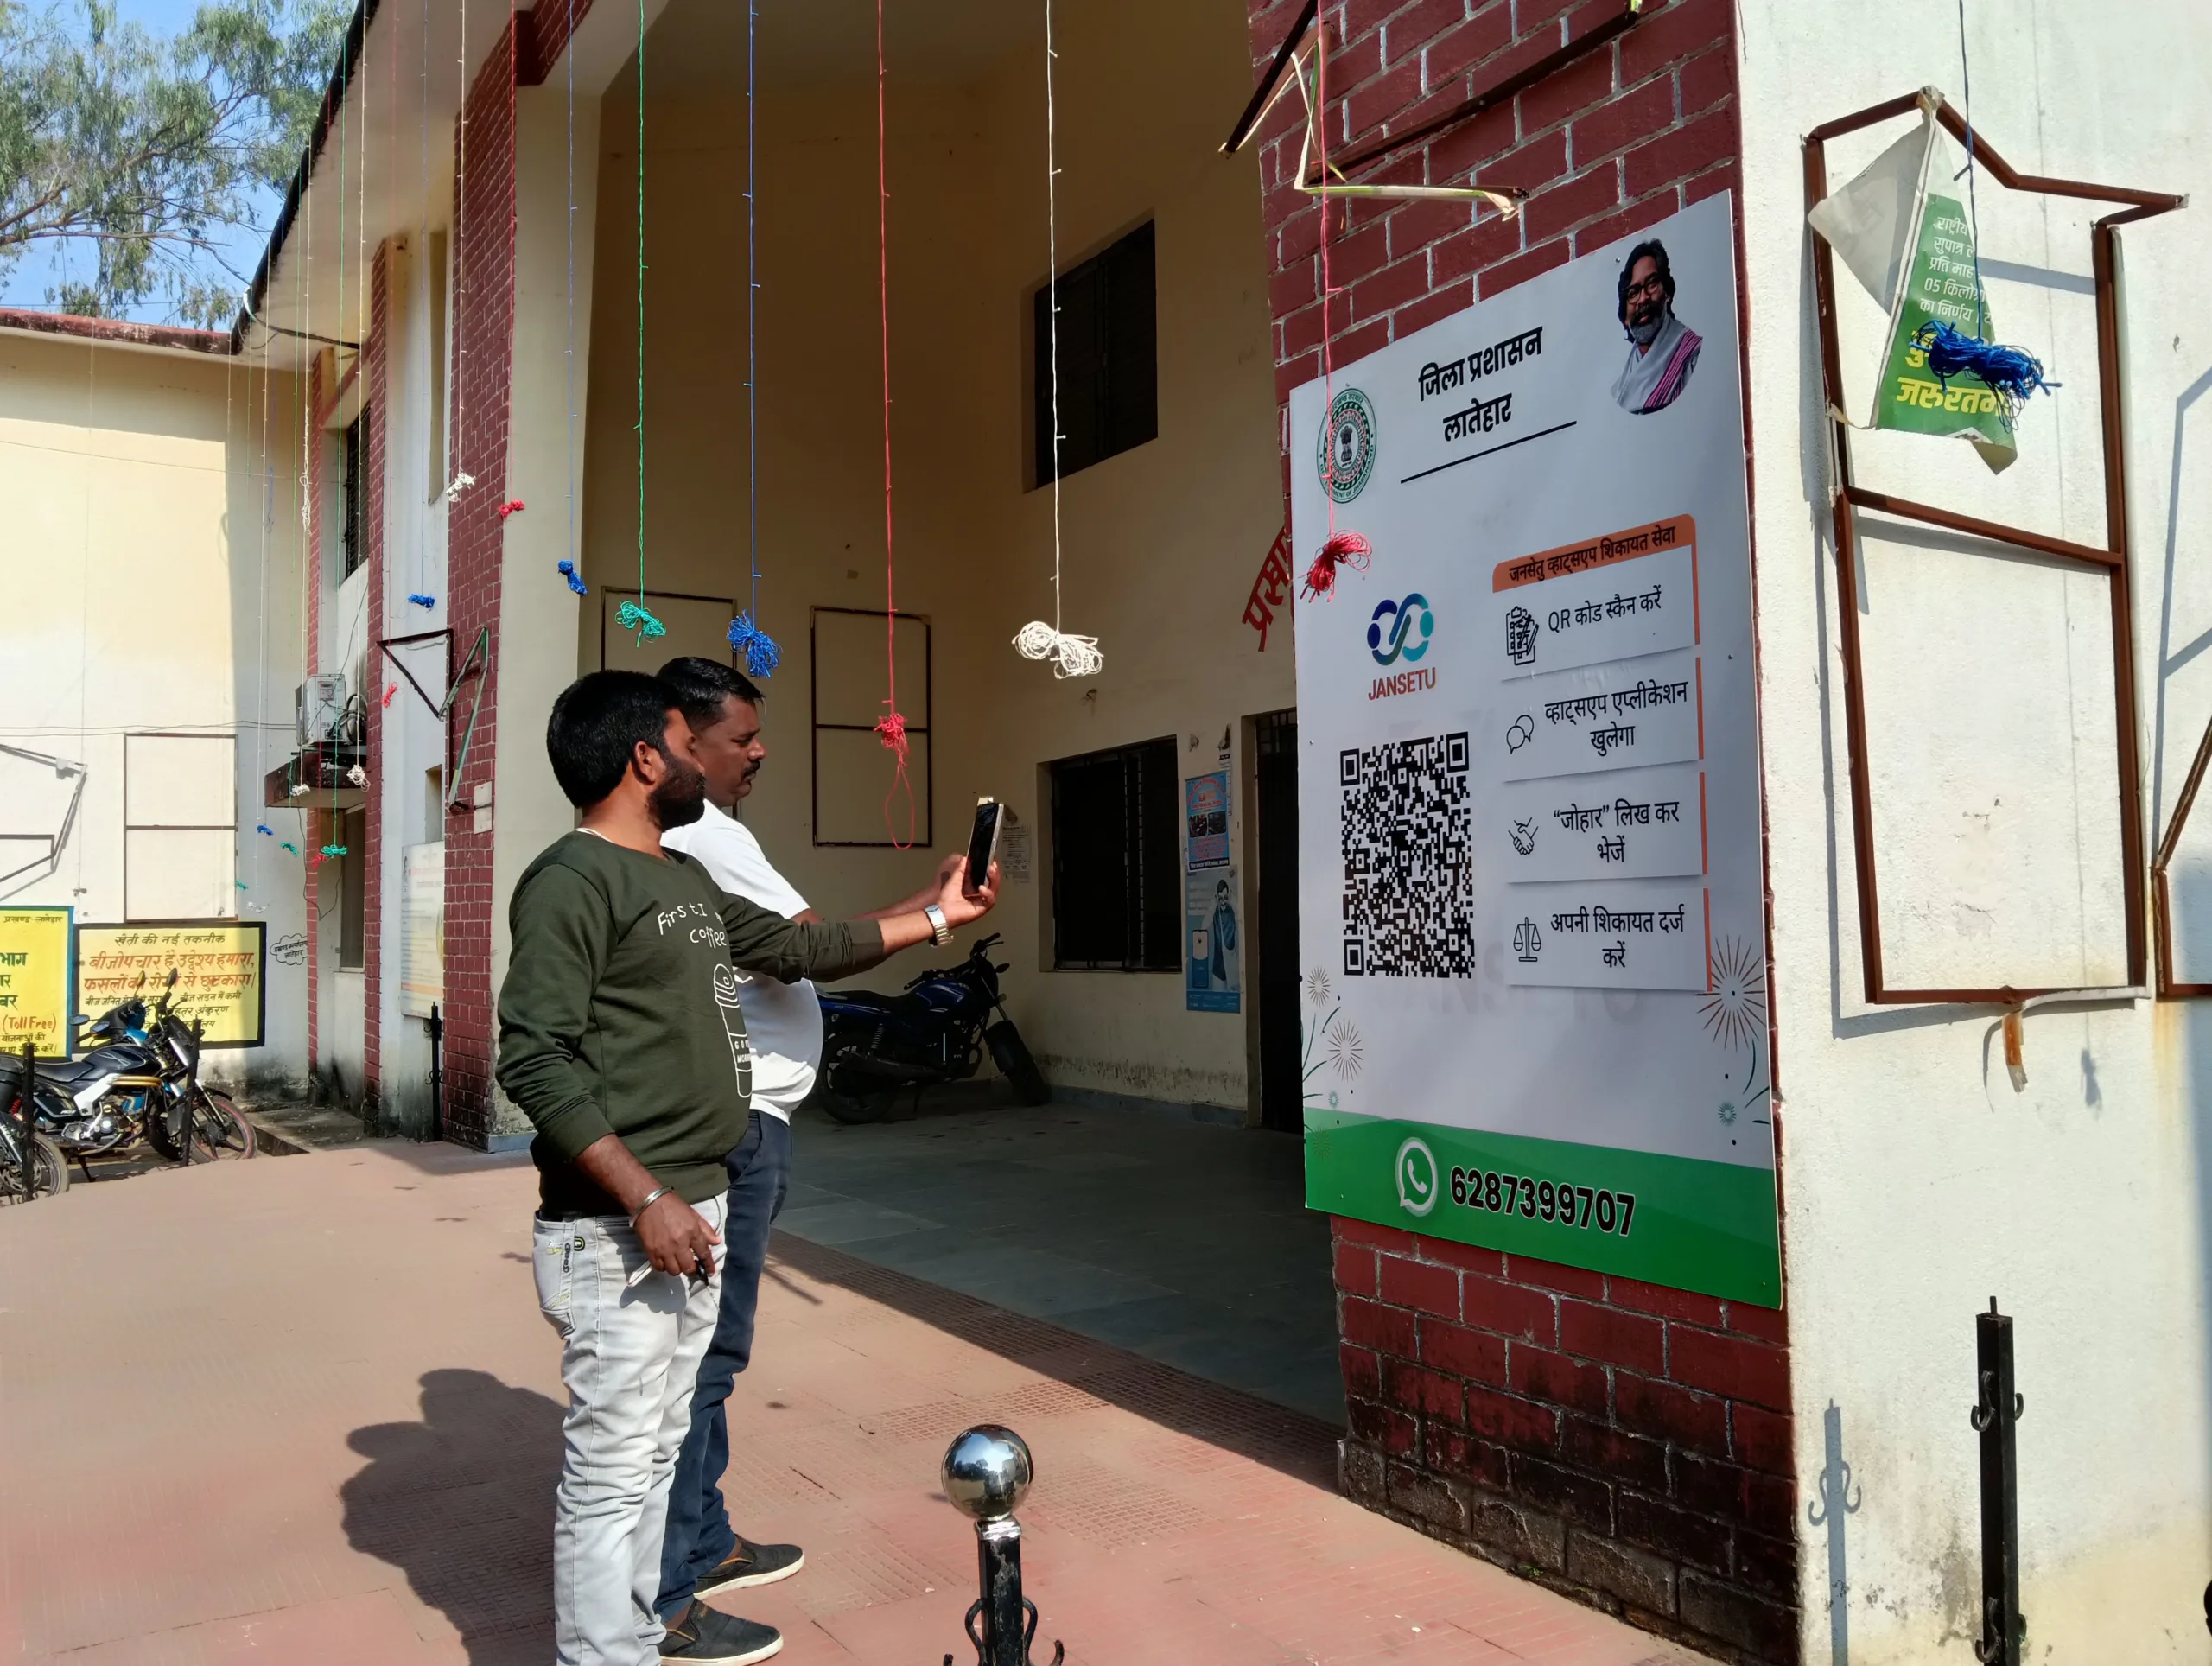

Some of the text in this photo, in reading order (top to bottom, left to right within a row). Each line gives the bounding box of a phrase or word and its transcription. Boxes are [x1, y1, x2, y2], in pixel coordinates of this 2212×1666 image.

[1933, 236, 1965, 256] सुपात्र
[1928, 255, 1976, 279] प्रति माह
[1923, 277, 1942, 293] 05
[1919, 297, 1936, 314] का
[1937, 298, 1974, 322] निर्णय
[1418, 326, 1543, 403] जिला प्रशासन
[1442, 392, 1513, 442] लातेहार
[1509, 524, 1676, 583] जनसेतु व्हाट्सएप शिकायत सेवा
[1548, 584, 1662, 633] QR कोड स्कैन करें
[1367, 666, 1437, 702] JANSETU
[1544, 678, 1688, 726] व्हाट्सएप एप्लीकेशन
[1589, 721, 1636, 757] खुलेगा
[1614, 798, 1651, 828] लिख
[1654, 801, 1680, 823] कर
[1596, 835, 1626, 863] भेजें
[1549, 903, 1685, 934] अपनी शिकायत दर्ज
[114, 932, 226, 949] खेती की नई तकनीक
[1601, 939, 1626, 969] करें
[88, 950, 163, 972] बीजोपचार
[1449, 1165, 1636, 1237] 6287399707
